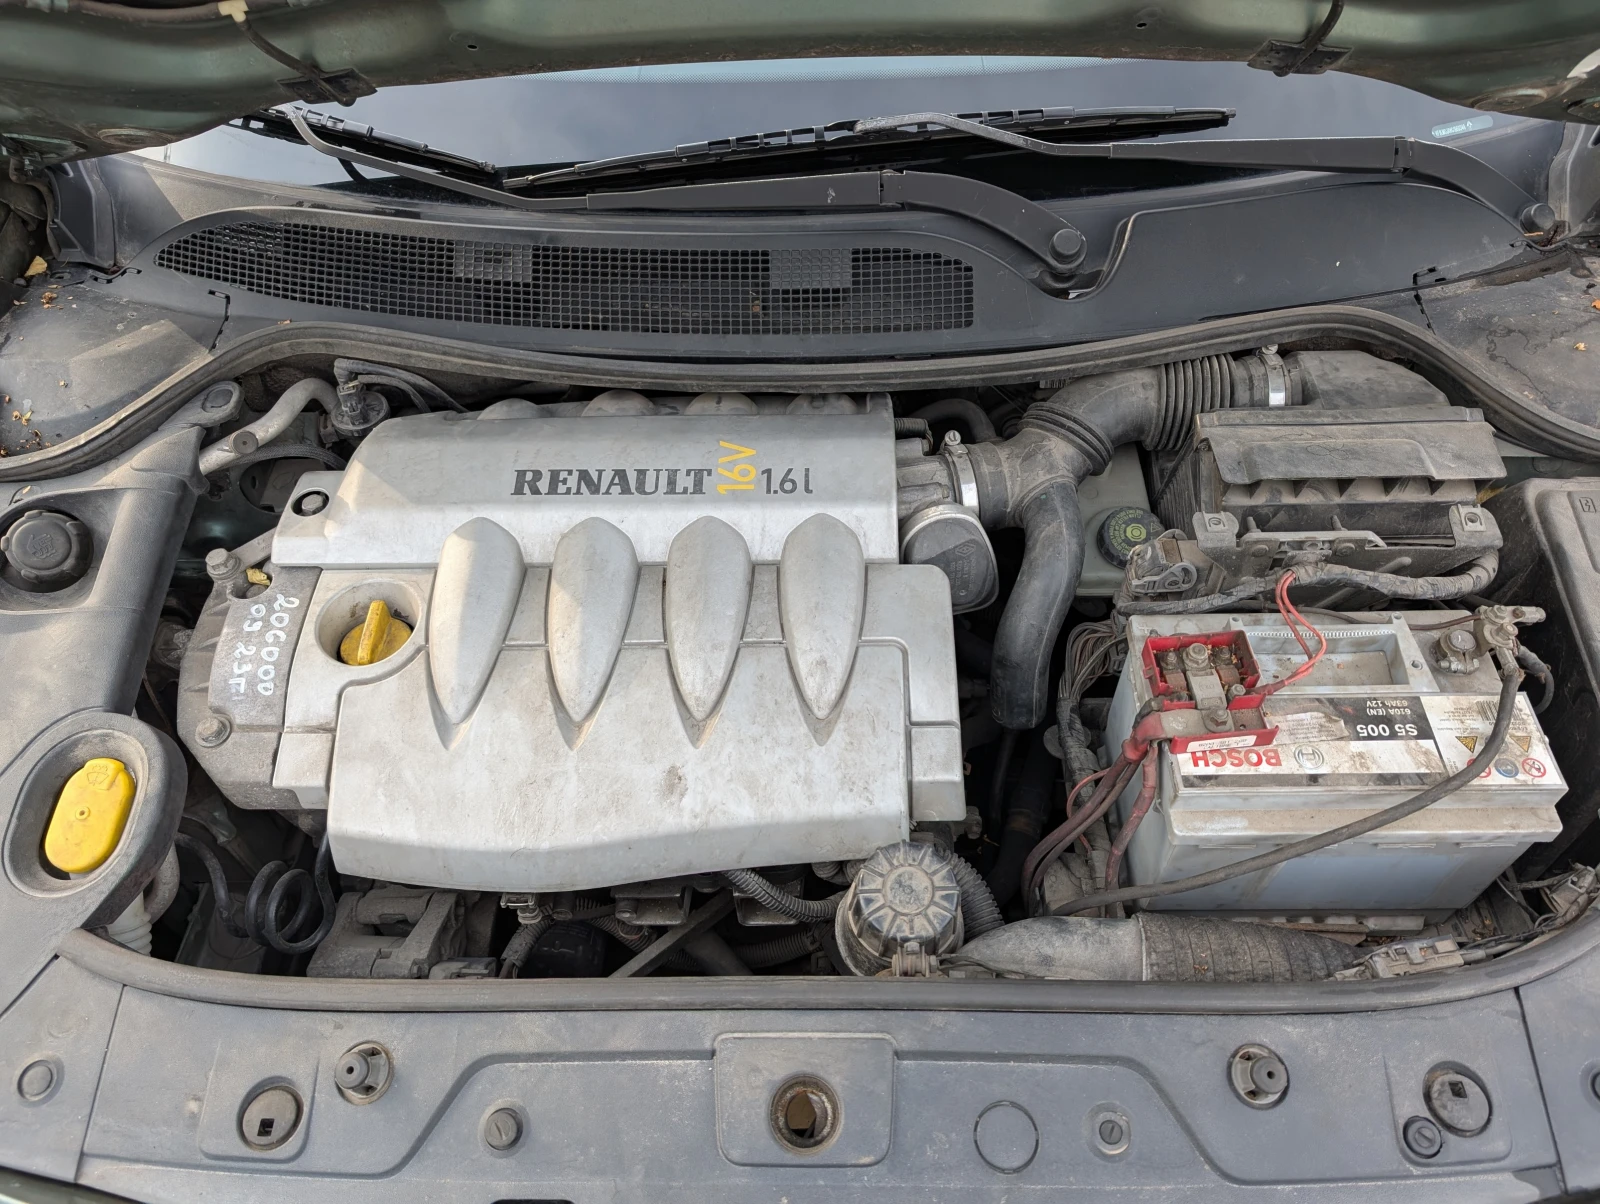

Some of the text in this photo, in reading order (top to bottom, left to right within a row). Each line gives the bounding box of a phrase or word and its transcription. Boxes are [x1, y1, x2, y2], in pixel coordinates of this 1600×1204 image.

[716, 440, 757, 495] 16V
[510, 468, 713, 495] RENAULT
[1366, 699, 1408, 708] 63Ah 12V
[1366, 707, 1411, 716] 610A (EN)
[1356, 723, 1418, 737] S5 005
[1190, 748, 1282, 768] BOSCH
